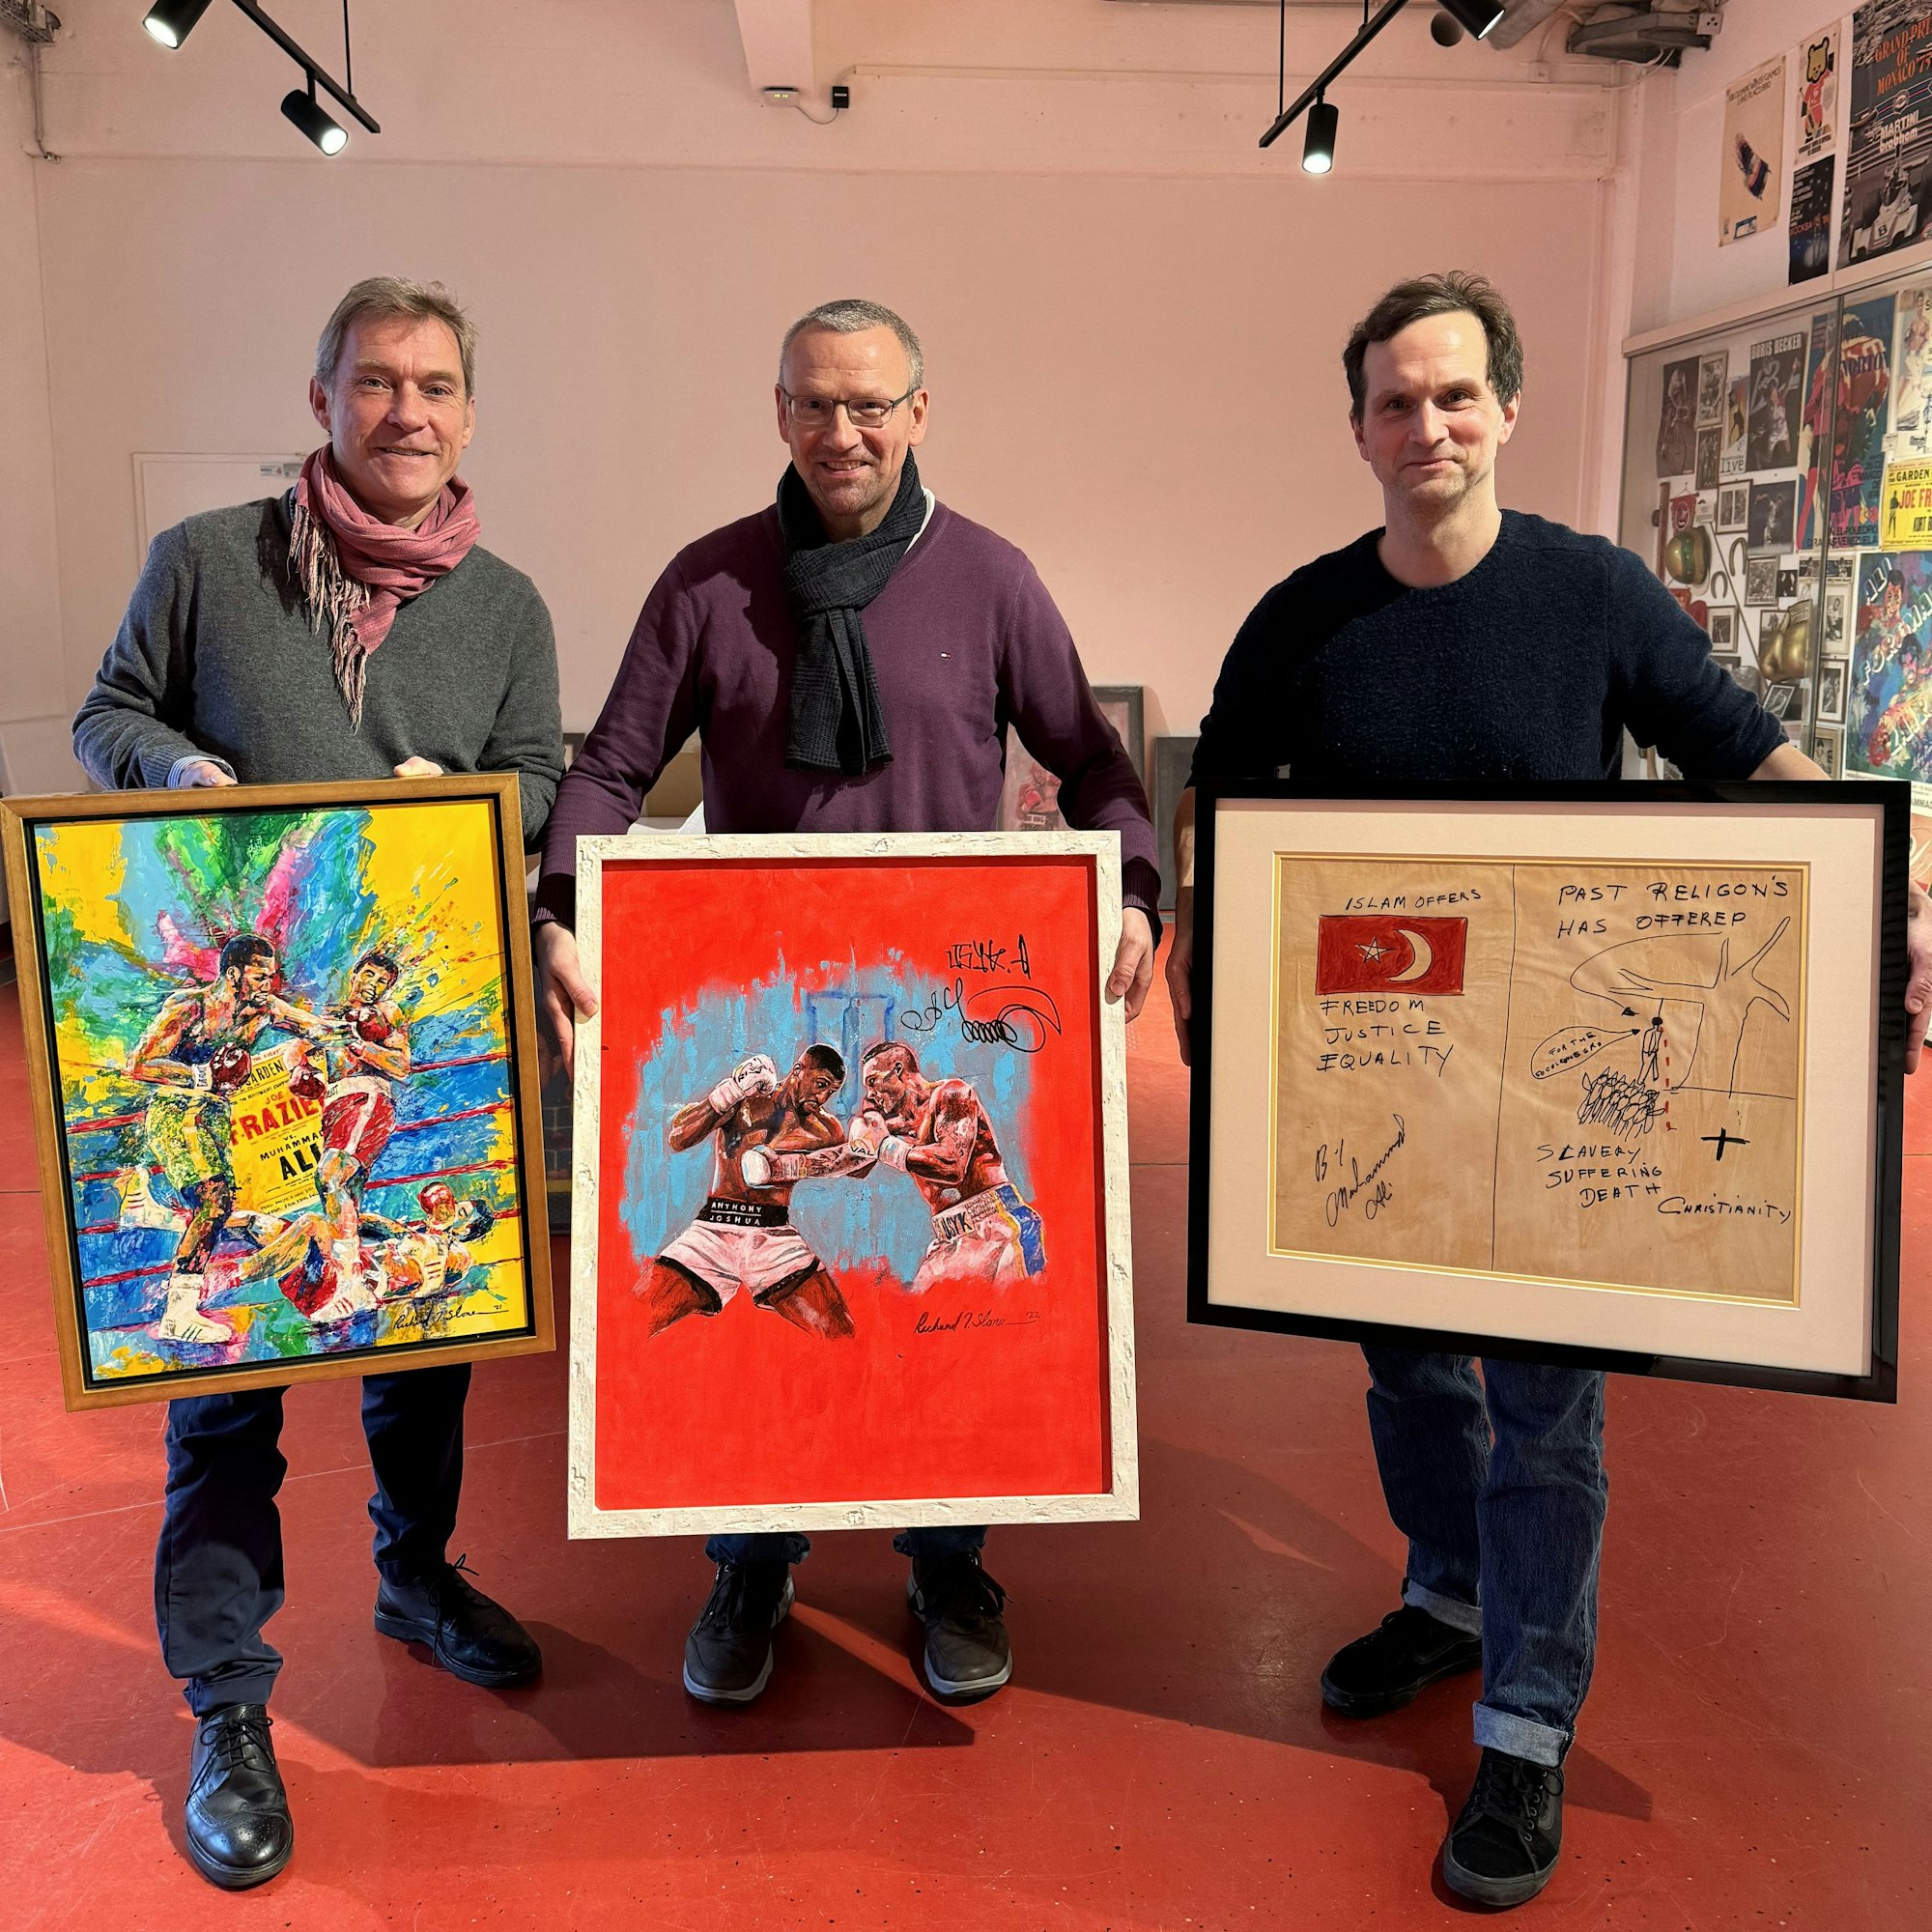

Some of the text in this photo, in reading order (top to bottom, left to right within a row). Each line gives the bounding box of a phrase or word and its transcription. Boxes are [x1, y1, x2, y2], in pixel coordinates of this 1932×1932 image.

[1911, 17, 1932, 42] PRI
[1896, 45, 1910, 67] OF
[1877, 61, 1916, 95] MONACO
[1881, 111, 1919, 137] MARTINI
[1751, 333, 1803, 360] BORIS BECKER
[1896, 469, 1930, 482] GARDEN
[1898, 488, 1932, 509] JOE FR
[1346, 889, 1482, 911] ISLAM OFFERS
[1558, 875, 1788, 905] PAST RELIGON'S
[1557, 918, 1607, 939] HAS
[1320, 999, 1425, 1016] FREEDOM
[1324, 1020, 1447, 1044] JUSTICE
[1548, 1031, 1597, 1056] FOR THE
[1317, 1044, 1454, 1077] EQUALITY
[266, 1091, 284, 1105] JOE
[230, 1097, 325, 1147] FRAZIE
[279, 1142, 322, 1181] ALI
[1537, 1145, 1641, 1165] SLAVERY
[1546, 1162, 1662, 1189] SUFFERING
[711, 1201, 762, 1213] ANTHONY
[1579, 1183, 1662, 1208] DEATH
[709, 1215, 761, 1226] JOSHUA
[940, 1211, 973, 1240] USYK
